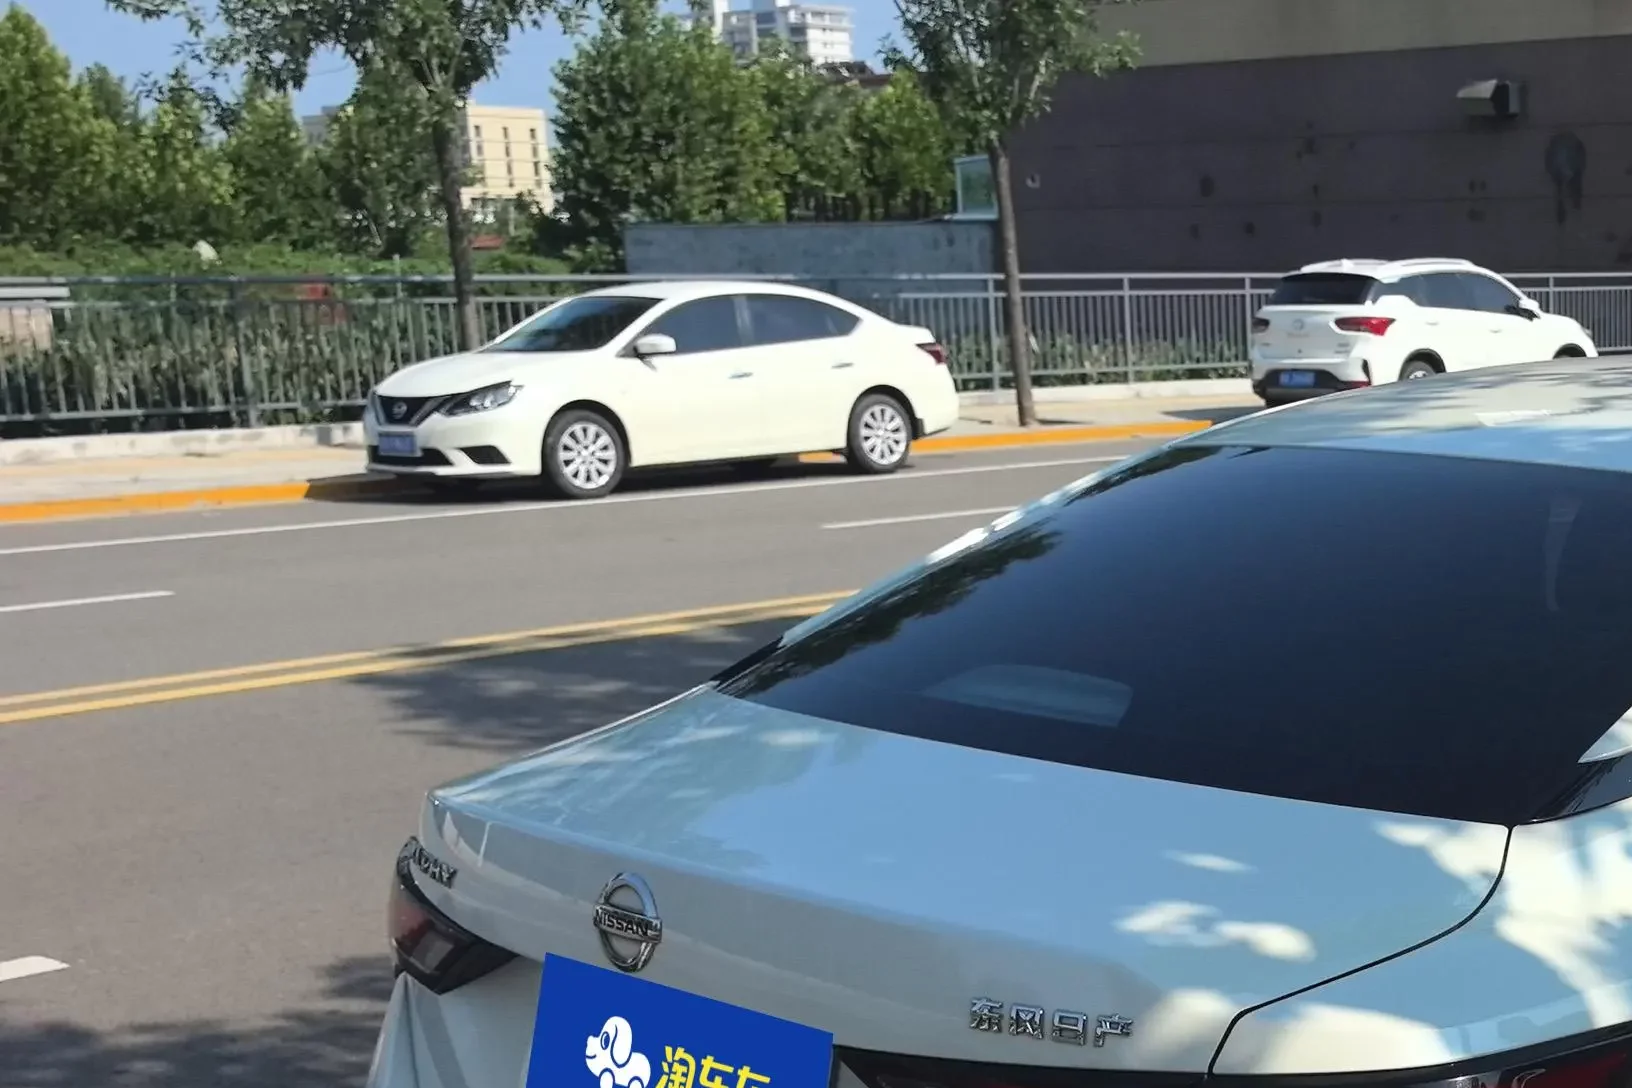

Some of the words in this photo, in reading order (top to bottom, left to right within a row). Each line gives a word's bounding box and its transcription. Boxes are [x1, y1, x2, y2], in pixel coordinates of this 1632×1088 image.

[594, 908, 648, 937] NISSAN
[969, 996, 1134, 1048] 东风日产
